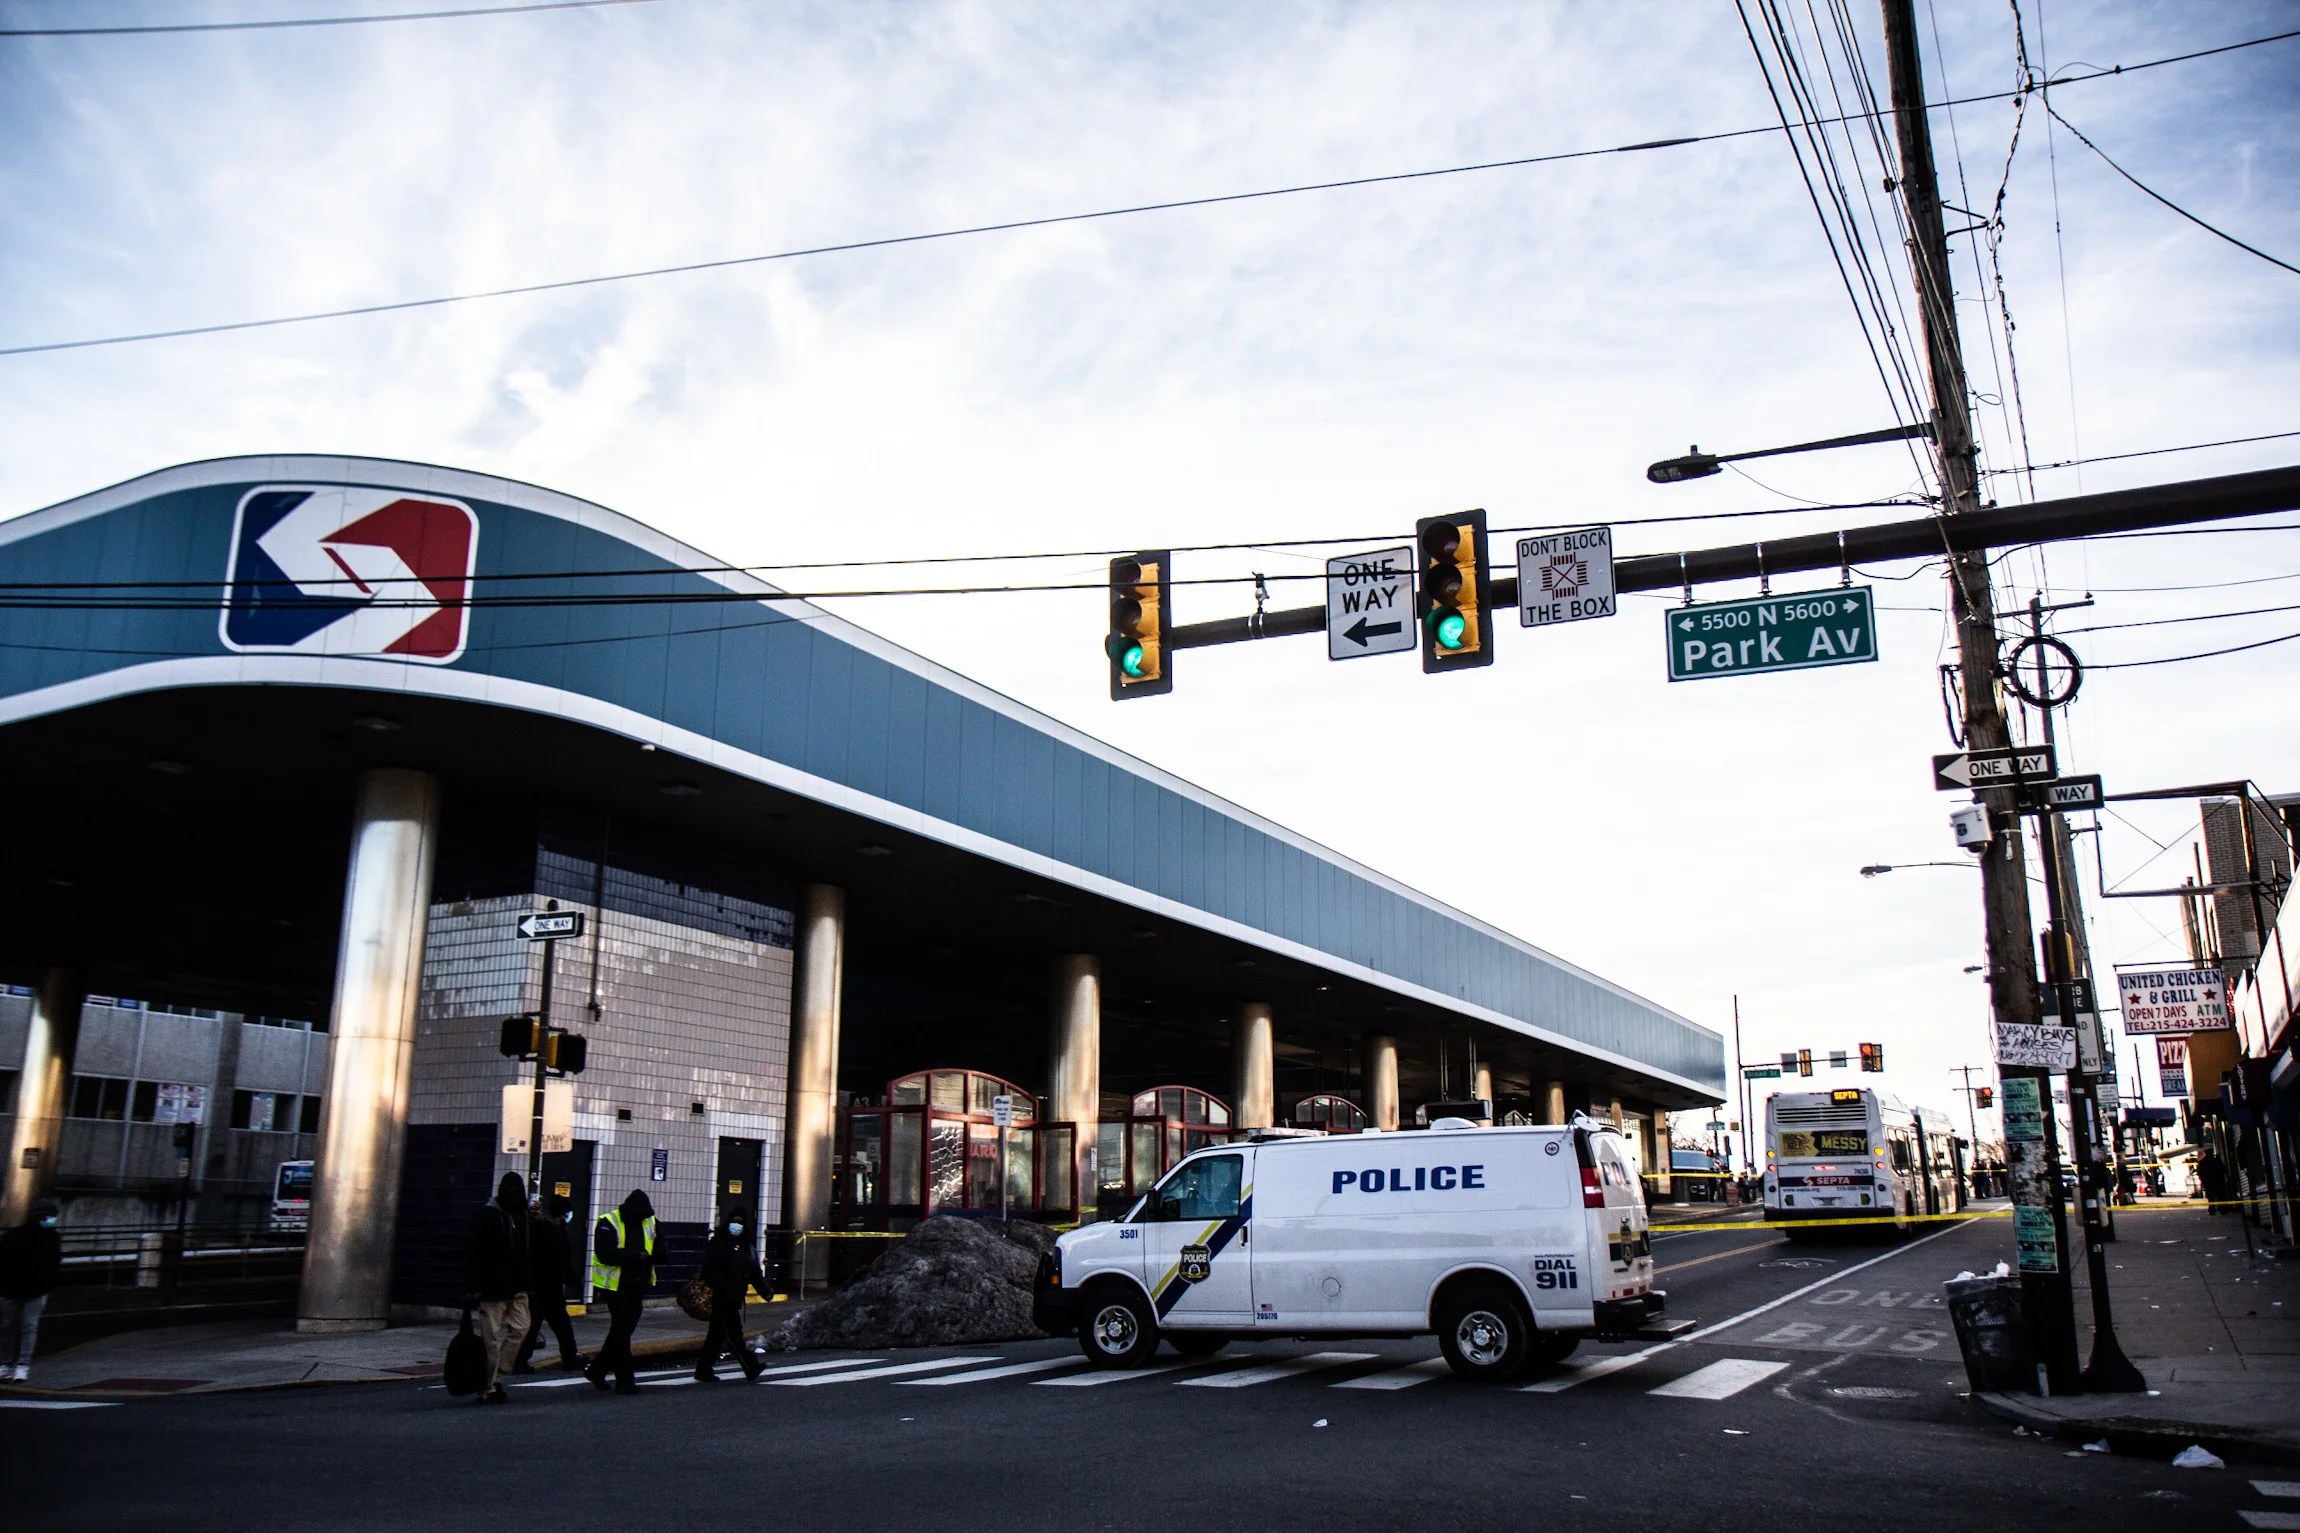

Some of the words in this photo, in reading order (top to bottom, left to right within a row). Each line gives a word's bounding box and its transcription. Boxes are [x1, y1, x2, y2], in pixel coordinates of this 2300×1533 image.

[1521, 533, 1559, 558] DON'T
[1563, 530, 1607, 552] BLOCK
[1344, 558, 1396, 586] ONE
[1342, 585, 1399, 614] WAY
[1526, 601, 1562, 624] THE
[1571, 595, 1610, 616] BOX
[1701, 610, 1751, 631] 5500
[1758, 604, 1777, 627] N
[1784, 600, 1837, 621] 5600
[1684, 629, 1784, 671] Park
[1807, 625, 1861, 659] Av
[1968, 760, 2001, 777] ONE
[2054, 785, 2088, 802] WAY
[534, 919, 552, 931] ONE
[554, 919, 571, 930] WAY
[2119, 973, 2164, 990] UNITED
[2167, 969, 2222, 987] CHICKEN
[2149, 991, 2158, 1005] &
[2161, 988, 2197, 1004] GRILL
[2129, 1007, 2154, 1020] OPEN
[2155, 1007, 2161, 1019] 7
[2163, 1005, 2187, 1018] DAYS
[2197, 1003, 2222, 1017] ATM
[2126, 1017, 2227, 1032] TEL:215-424-3224
[2082, 1057, 2098, 1067] NLY
[1833, 1090, 1858, 1101] SEPTA
[1820, 1134, 1867, 1151] MESSY
[1332, 1163, 1485, 1194] POLICE
[1816, 1176, 1850, 1186] SEPTA
[1119, 1229, 1138, 1239] 3501
[1183, 1253, 1207, 1263] POLICE
[1534, 1259, 1576, 1270] DIAL
[1536, 1271, 1578, 1289] 911
[1752, 1321, 1948, 1352] BUS
